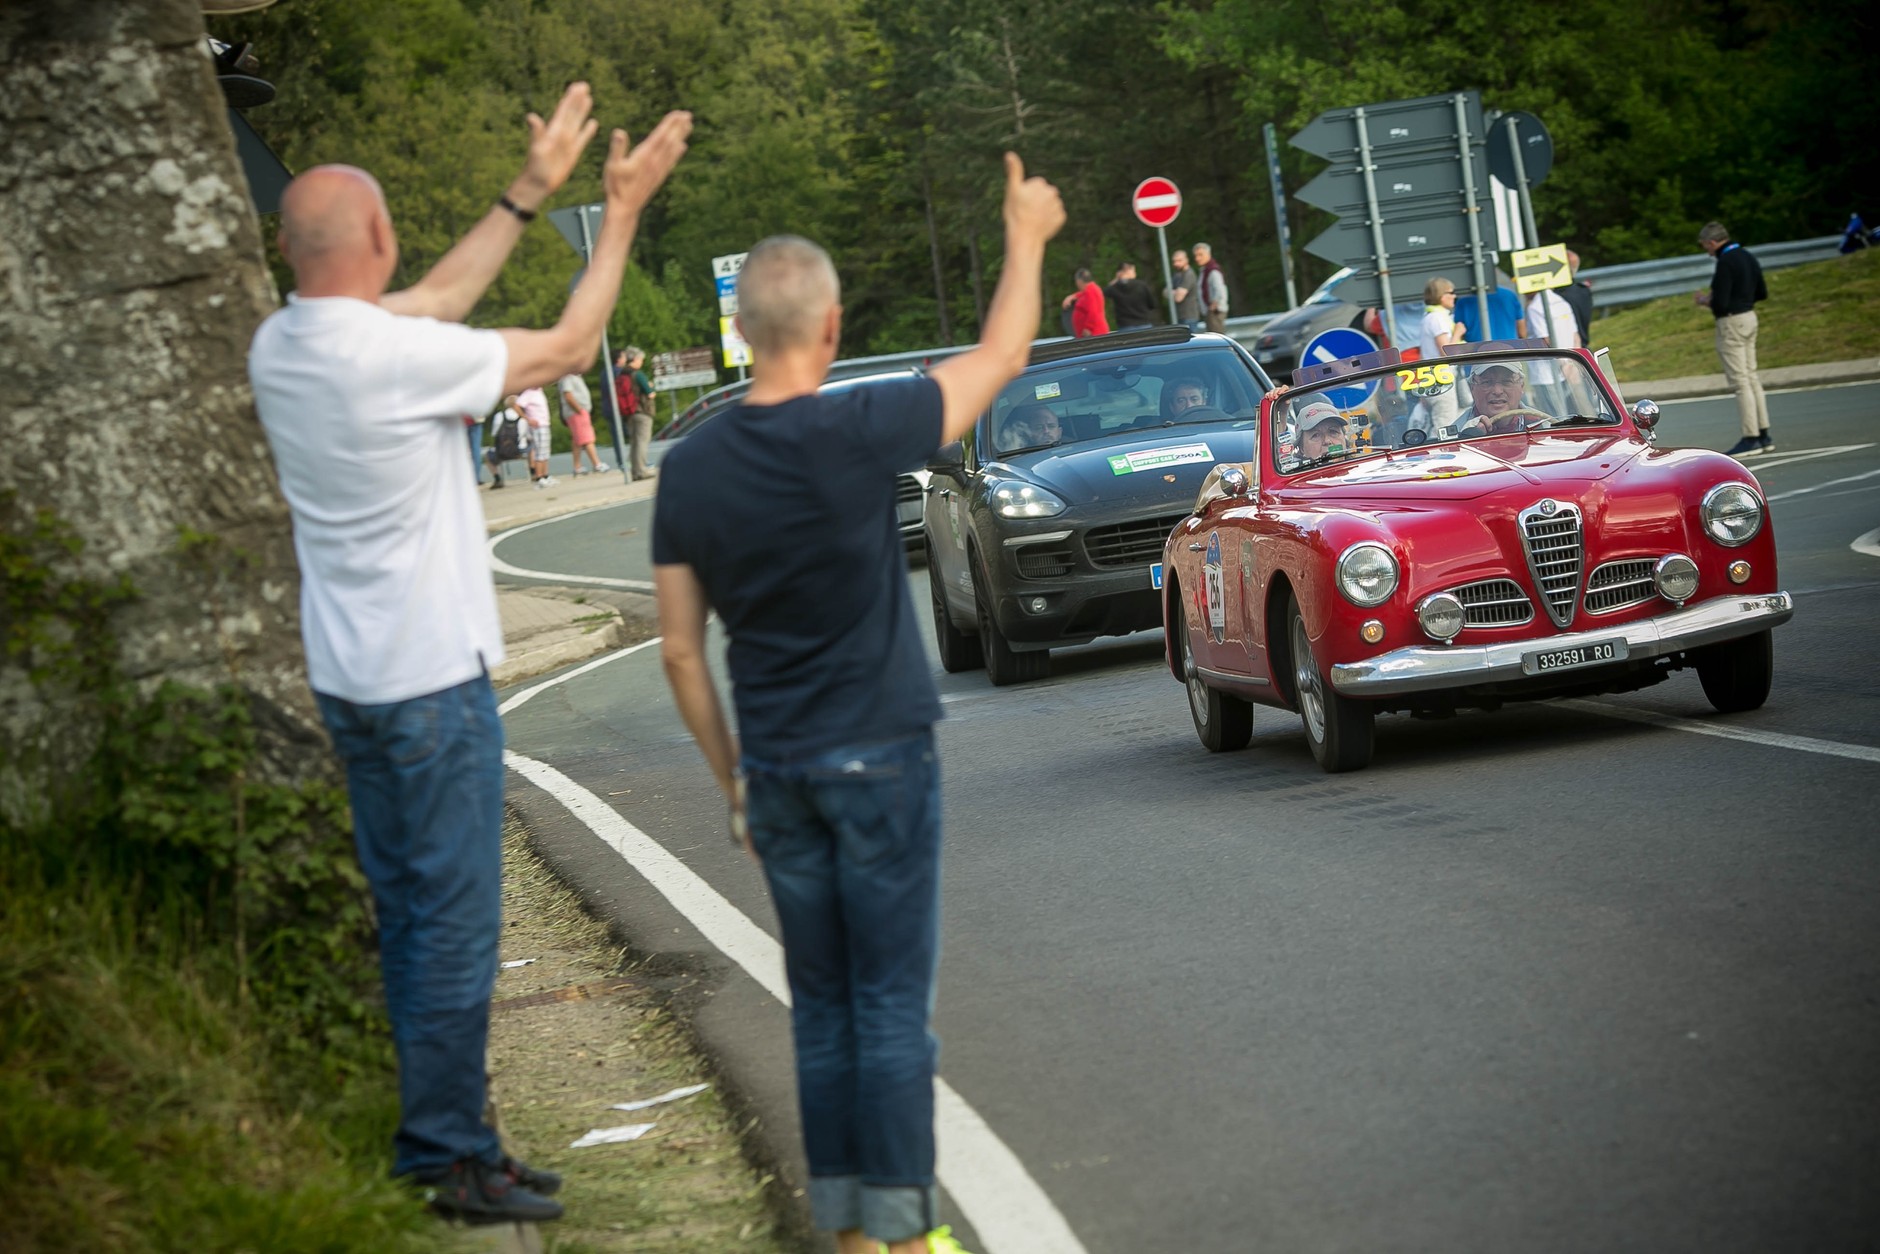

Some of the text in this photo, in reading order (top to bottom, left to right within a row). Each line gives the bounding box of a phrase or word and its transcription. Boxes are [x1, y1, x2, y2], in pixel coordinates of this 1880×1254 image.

[1396, 364, 1455, 391] 256
[1133, 457, 1160, 466] SUPPORT
[1175, 452, 1202, 460] 250A
[1209, 573, 1221, 609] 256
[1540, 648, 1586, 669] 332591
